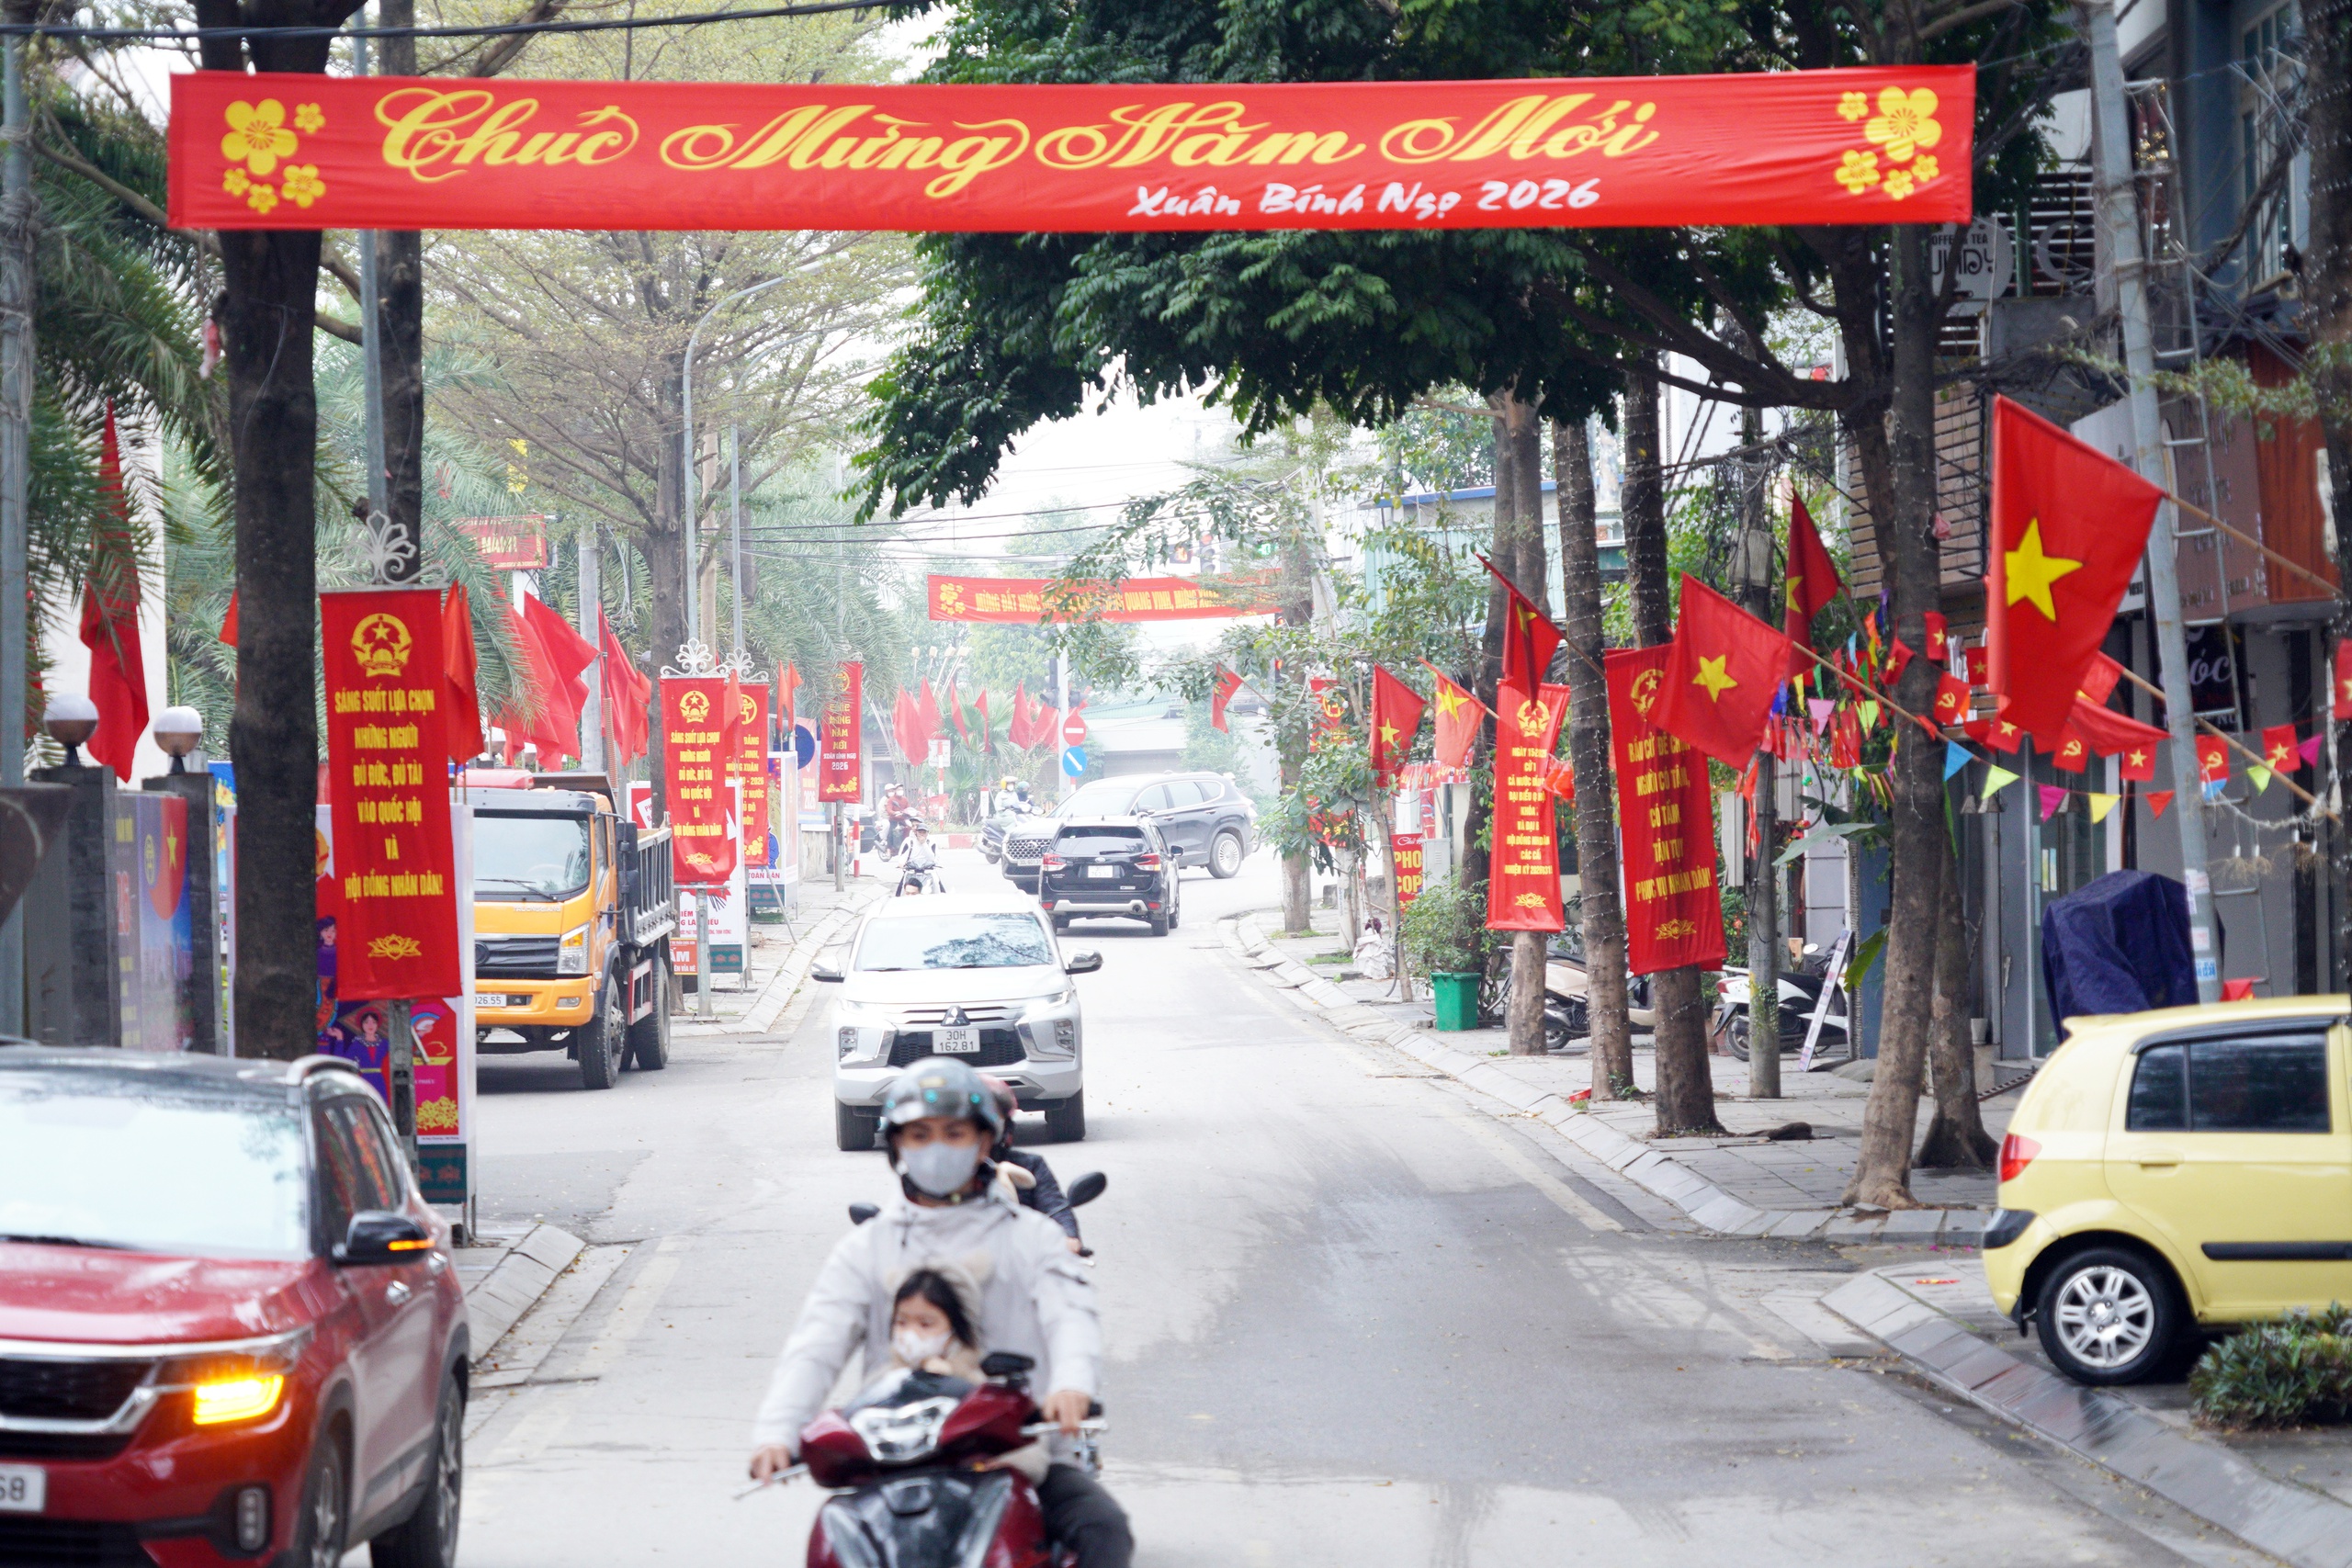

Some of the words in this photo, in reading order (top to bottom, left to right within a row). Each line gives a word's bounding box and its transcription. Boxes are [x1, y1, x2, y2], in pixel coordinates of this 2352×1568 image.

[374, 87, 639, 183] Chúc
[661, 104, 1030, 198] Mừng
[1035, 101, 1366, 170] Năm
[1380, 93, 1659, 164] Mới
[1126, 186, 1240, 217] Xuân
[1259, 183, 1366, 216] Bính
[1477, 178, 1600, 210] 2026
[1971, 233, 1988, 244] TEA
[334, 686, 361, 714] SÁNG
[362, 682, 386, 712] SUỐT
[408, 689, 435, 716] CHỌN
[384, 833, 399, 860] VÀ
[940, 1042, 974, 1051] 162.81
[946, 1031, 967, 1040] 30H
